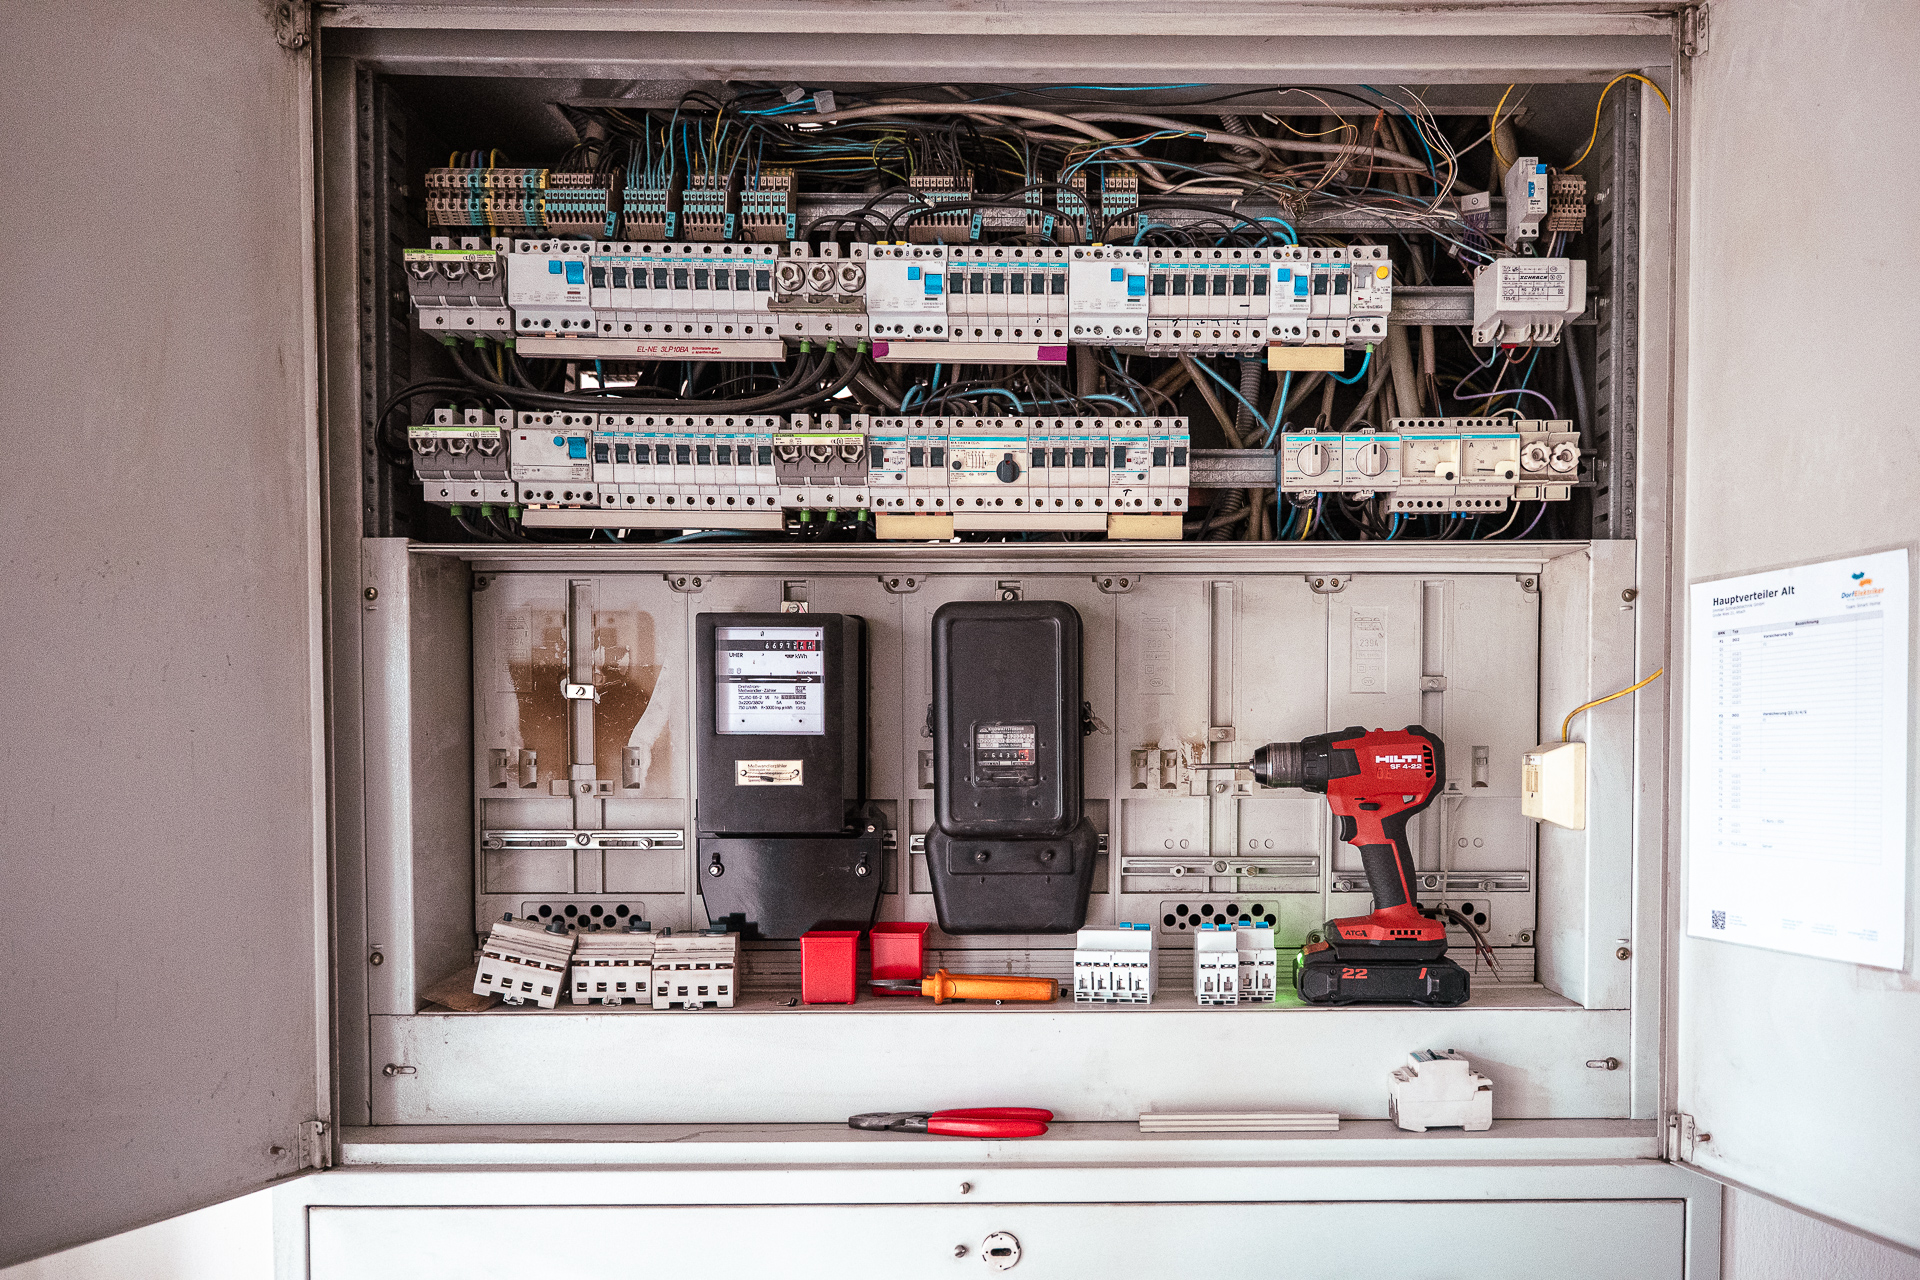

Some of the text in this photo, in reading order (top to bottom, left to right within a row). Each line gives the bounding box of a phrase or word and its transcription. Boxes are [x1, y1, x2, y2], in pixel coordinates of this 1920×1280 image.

[1713, 586, 1795, 606] Hauptverteiler Alt
[1841, 588, 1884, 599] DorfElektriker
[1359, 639, 1379, 647] 2394
[1376, 755, 1422, 763] HILTI
[1342, 968, 1368, 979] 22
